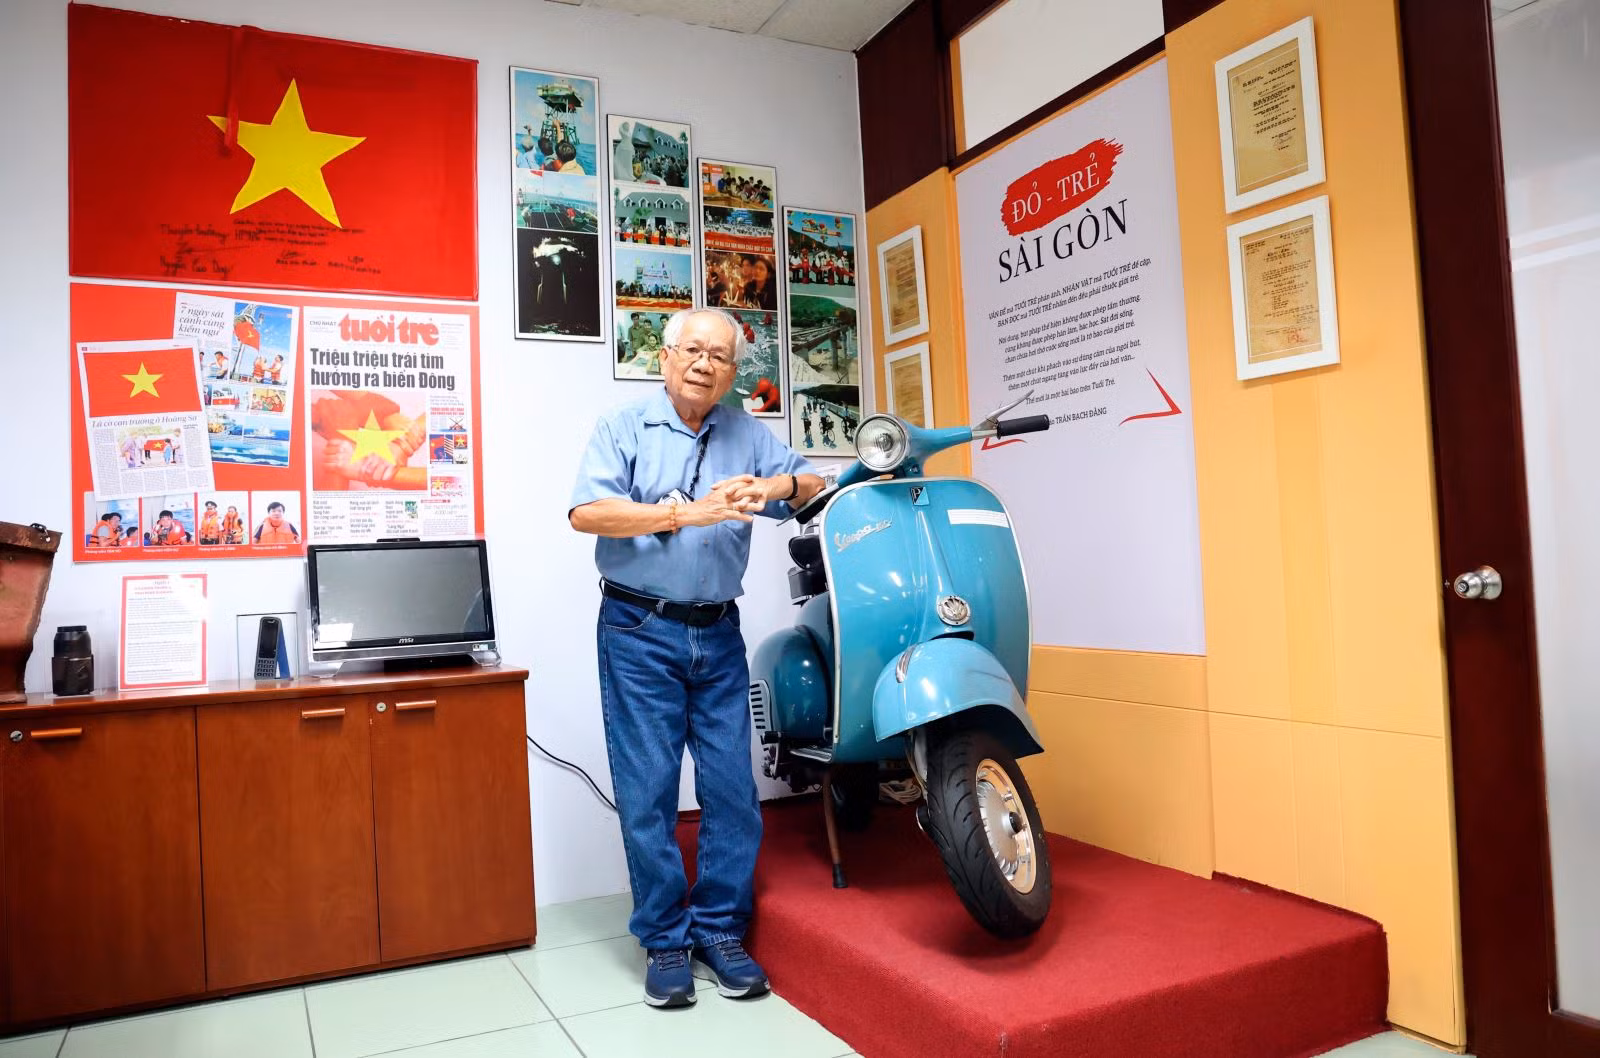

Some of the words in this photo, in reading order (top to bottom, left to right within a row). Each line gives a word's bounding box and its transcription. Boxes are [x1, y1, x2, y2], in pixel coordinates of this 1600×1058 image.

[1012, 181, 1042, 224] ĐỎ
[1057, 152, 1100, 202] TRẺ
[999, 236, 1044, 283] SÀI
[1053, 199, 1127, 259] GÒN
[1014, 300, 1027, 311] TUỔI
[1028, 296, 1038, 307] TRẺ
[1062, 282, 1080, 294] NHÂN
[1080, 278, 1092, 288] VẬT
[1103, 267, 1118, 280] TUỔI
[1119, 262, 1131, 274] TRẺ
[1028, 306, 1041, 317] TUỔI
[1042, 302, 1052, 312] TRẺ
[1102, 281, 1117, 292] thuộc
[1062, 314, 1078, 325] không
[1093, 305, 1106, 316] phép
[338, 314, 395, 343] tuổi
[396, 317, 440, 346] trẻ
[310, 348, 350, 369] Triệu
[353, 350, 388, 369] triệu
[391, 352, 417, 368] trái
[421, 353, 444, 369] tim
[311, 368, 361, 389] hướng
[364, 371, 380, 387] ra
[383, 369, 415, 388] biển
[418, 372, 455, 391] Đông
[1092, 380, 1104, 390] Tuổi
[1056, 414, 1071, 424] TRẦN
[1072, 411, 1088, 420] BẠCH
